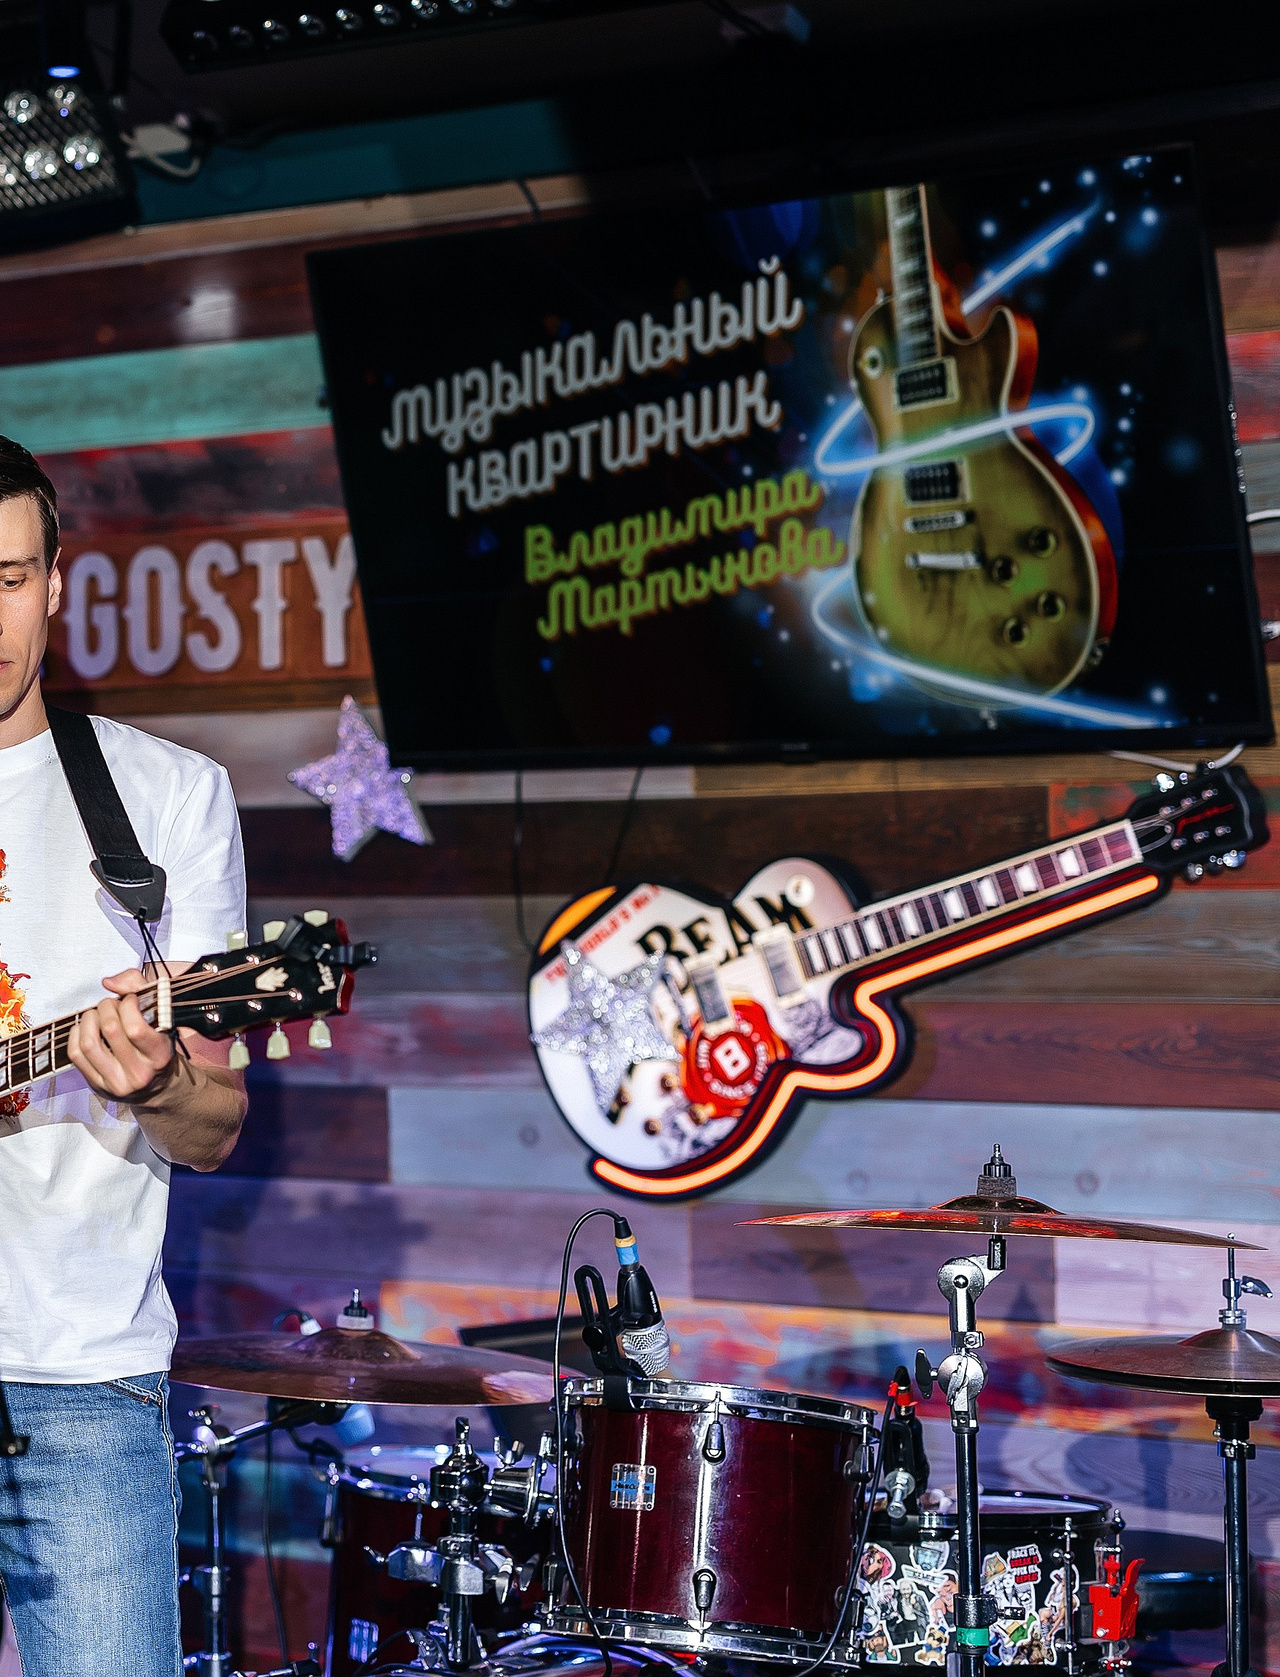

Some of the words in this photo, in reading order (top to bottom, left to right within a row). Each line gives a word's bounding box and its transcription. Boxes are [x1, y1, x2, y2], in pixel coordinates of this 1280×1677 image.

[524, 468, 823, 583] Владимира
[536, 517, 847, 640] Мартынова
[62, 534, 358, 679] GOSTY
